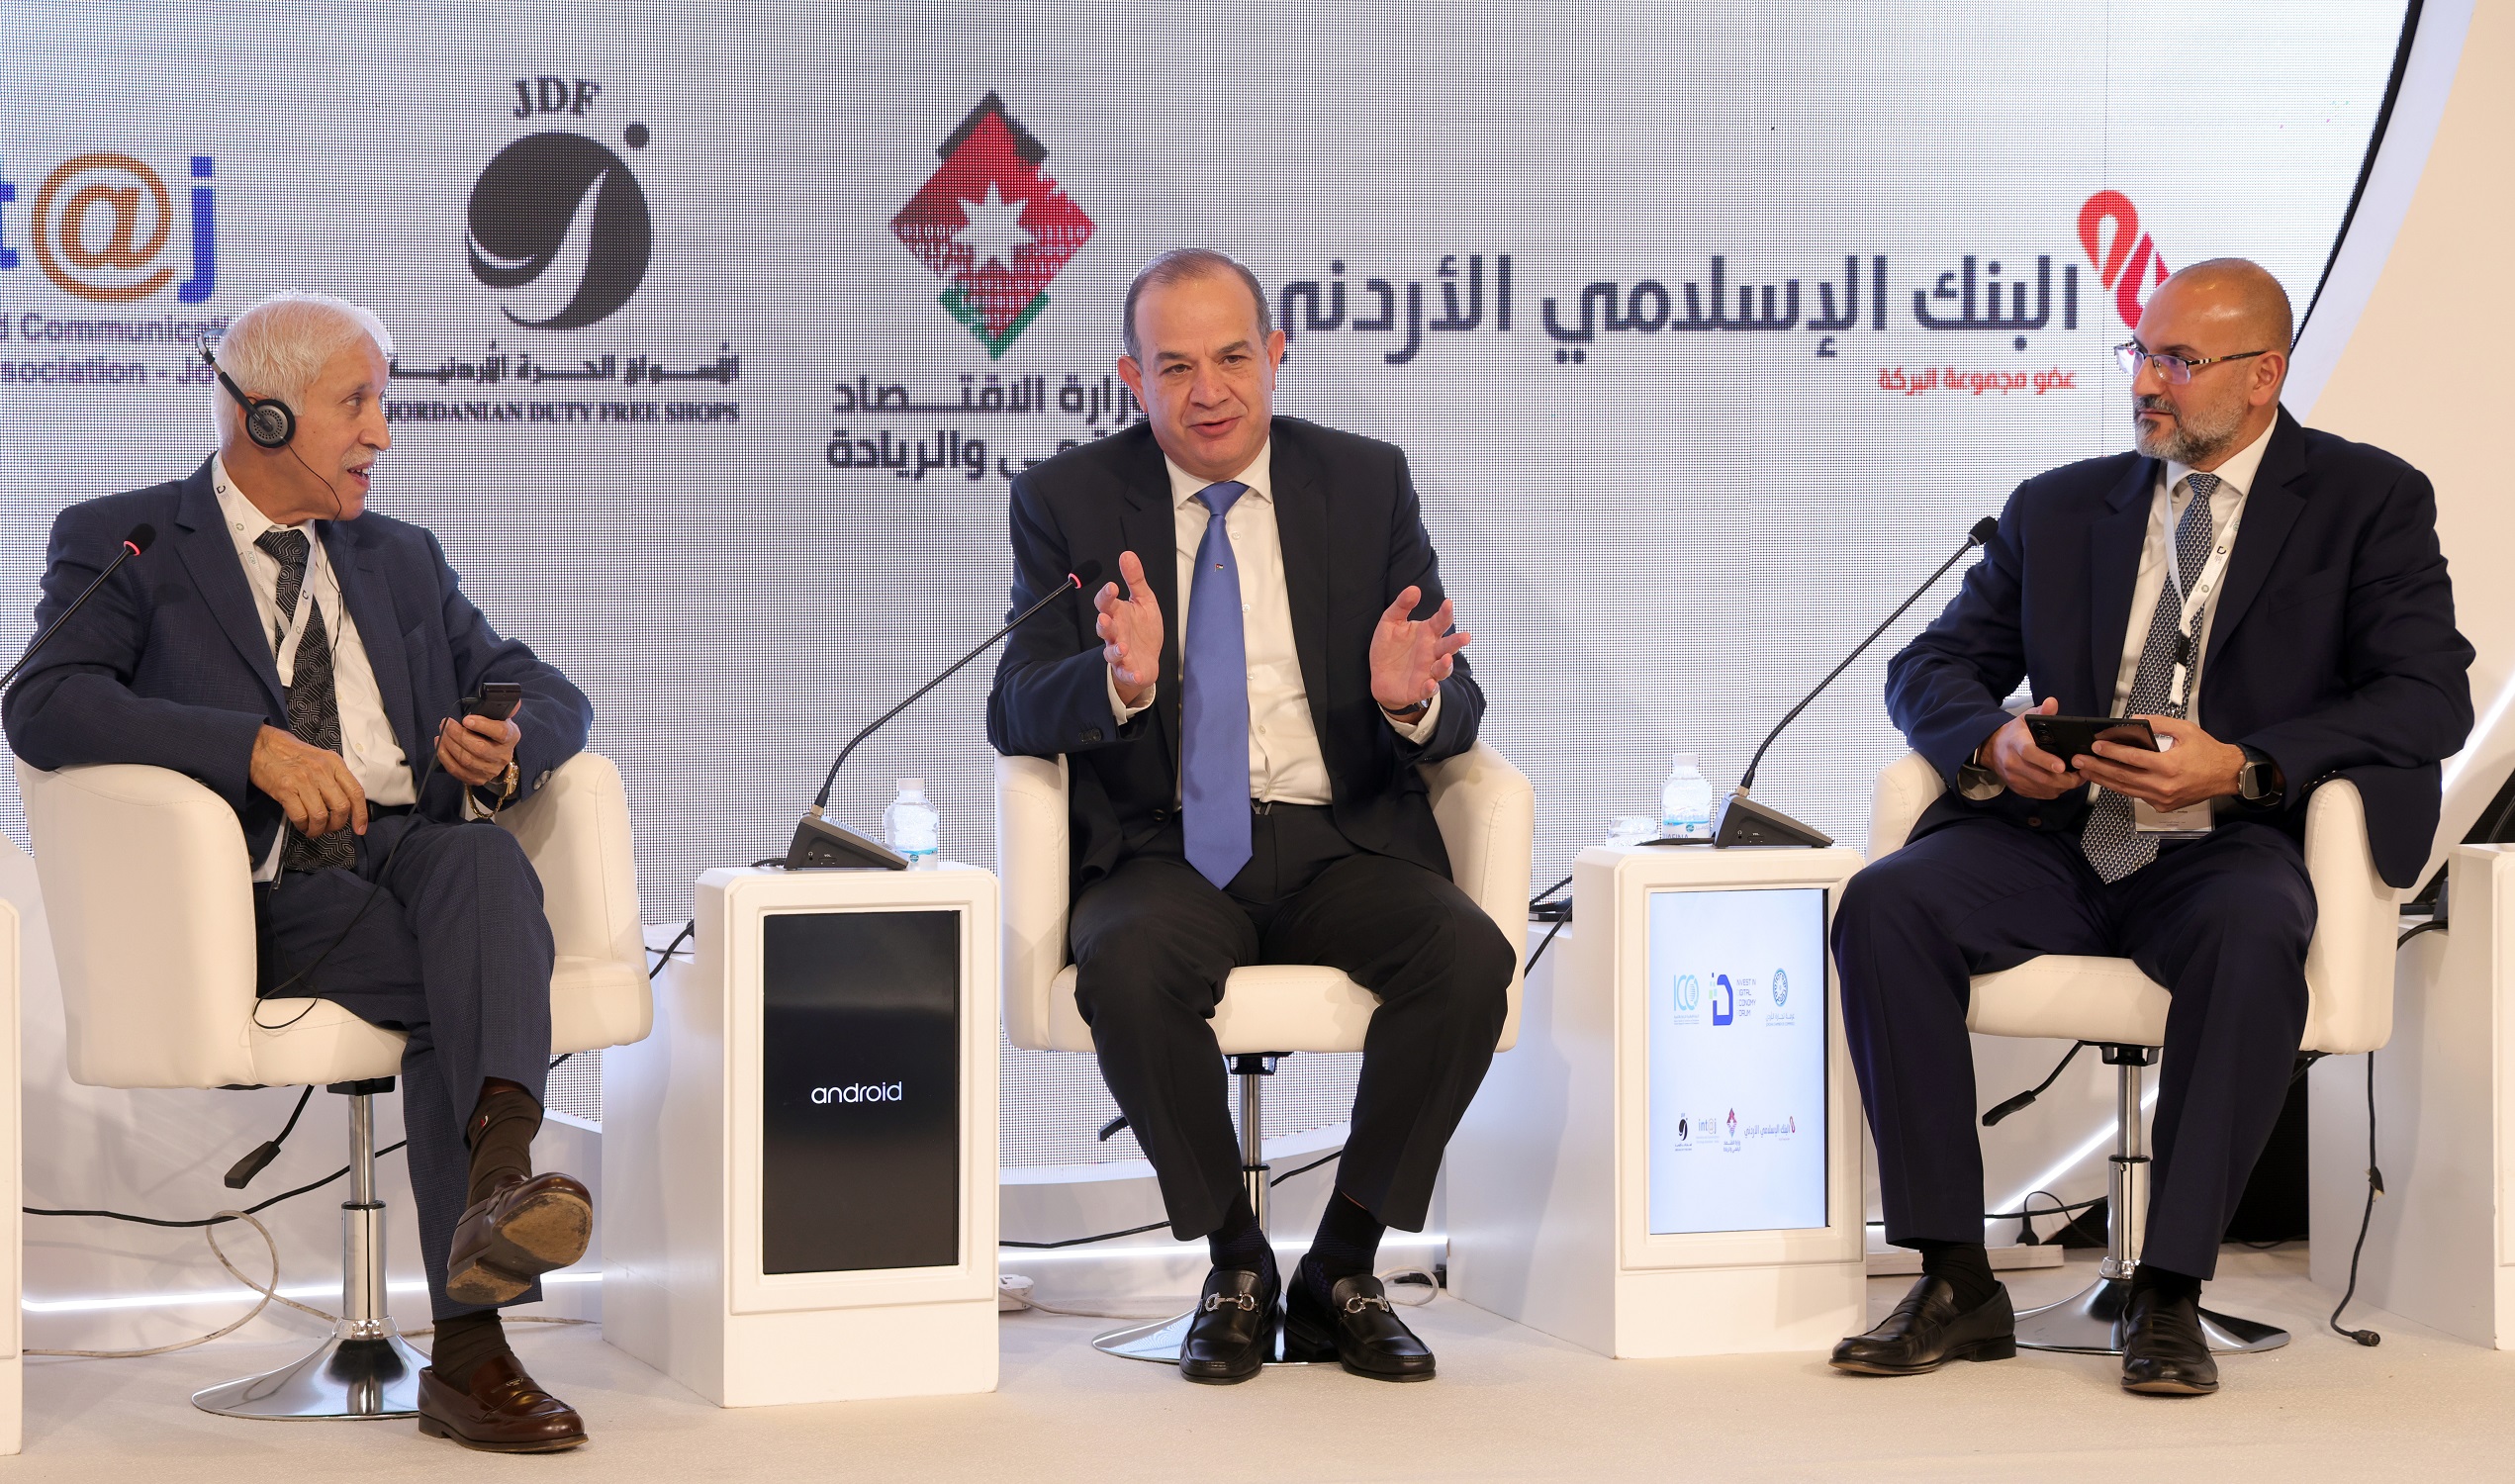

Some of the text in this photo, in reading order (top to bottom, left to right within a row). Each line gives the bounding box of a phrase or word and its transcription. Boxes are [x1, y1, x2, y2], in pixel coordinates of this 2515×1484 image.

[513, 76, 602, 120] JDF
[1542, 254, 1888, 364] الإسلامي
[1912, 255, 2079, 351] البنك
[1877, 363, 2077, 397] عضو مجموعة البركة
[386, 400, 740, 423] JORDANIAN DUTY FREE SHOPS
[826, 428, 988, 482] والريادة
[810, 1080, 902, 1105] android
